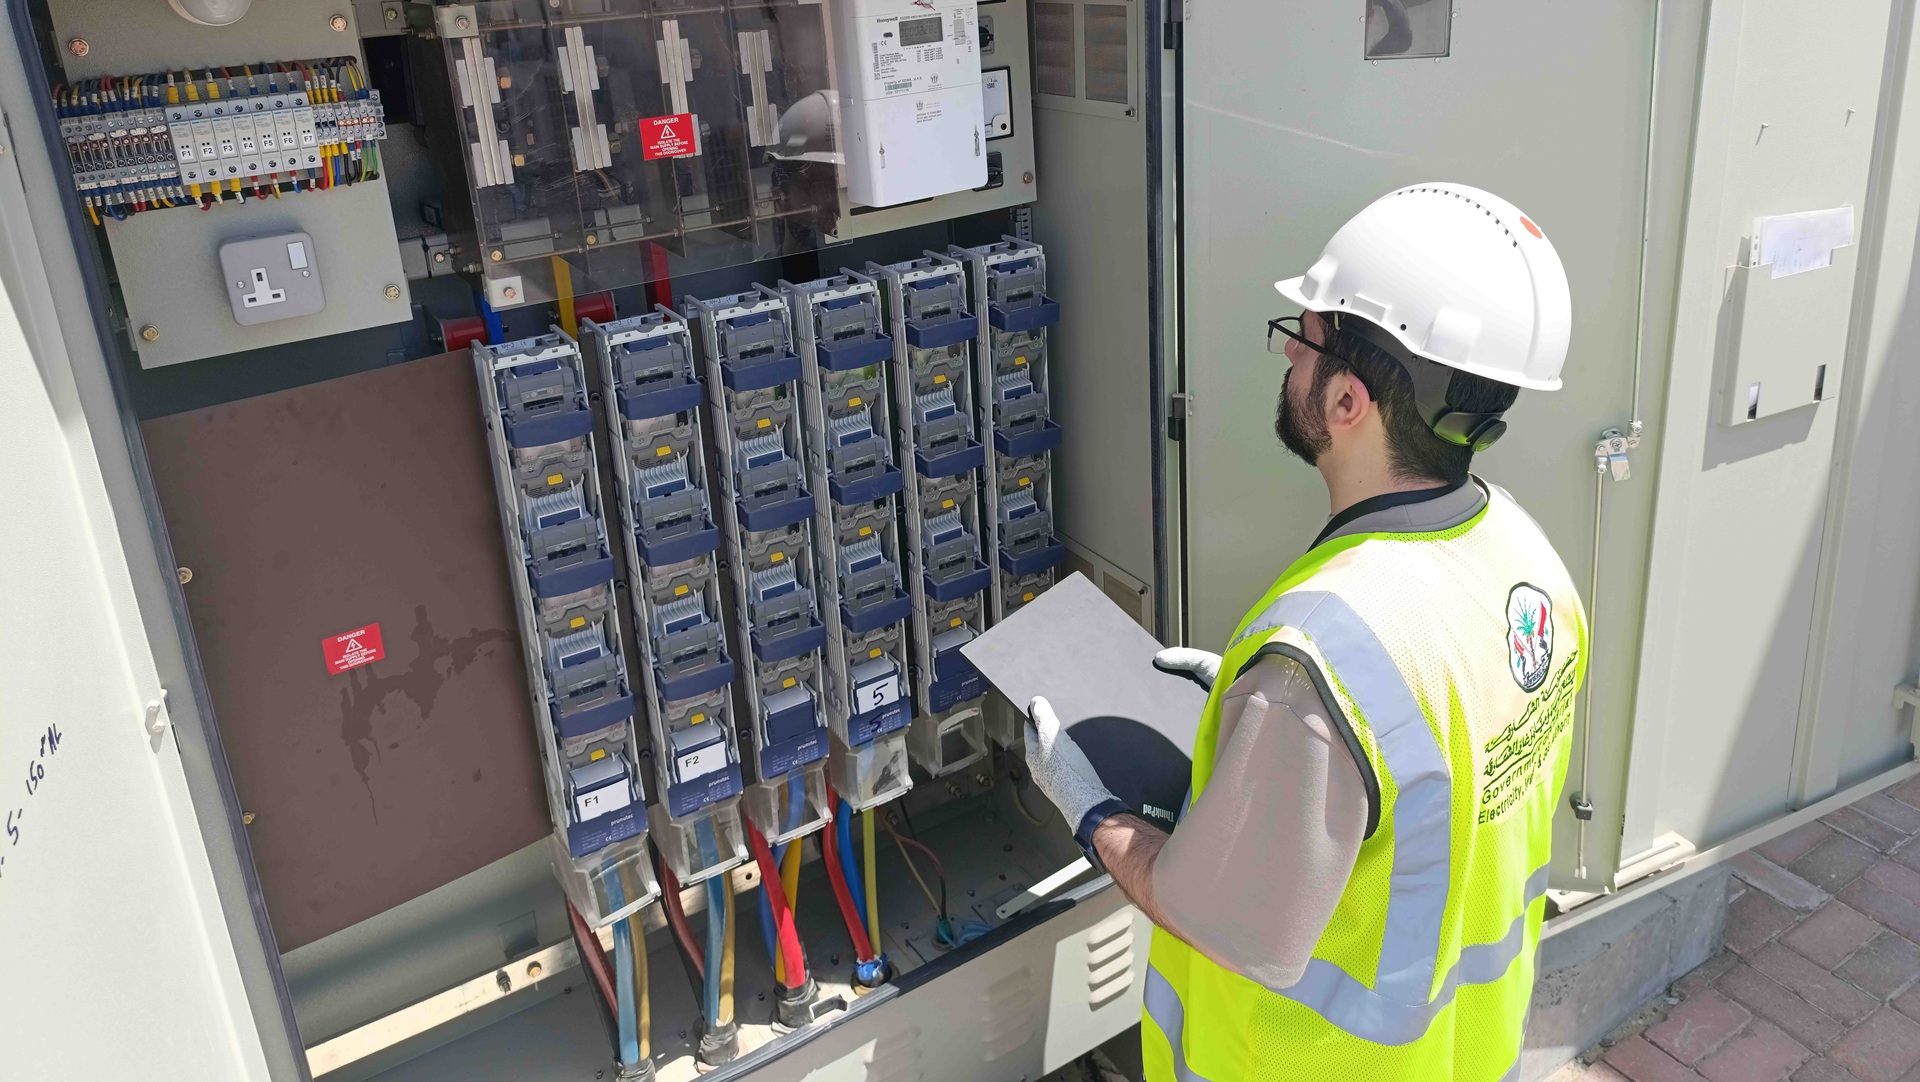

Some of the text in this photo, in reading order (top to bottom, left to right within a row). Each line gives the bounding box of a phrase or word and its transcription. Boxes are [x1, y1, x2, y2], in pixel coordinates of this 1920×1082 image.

[653, 117, 679, 126] DANGER
[337, 630, 366, 642] DANGER
[873, 682, 888, 706] 5
[685, 756, 700, 768] F2
[1482, 741, 1543, 804] Governm
[584, 796, 599, 807] F1
[1142, 804, 1174, 822] ThinkPad
